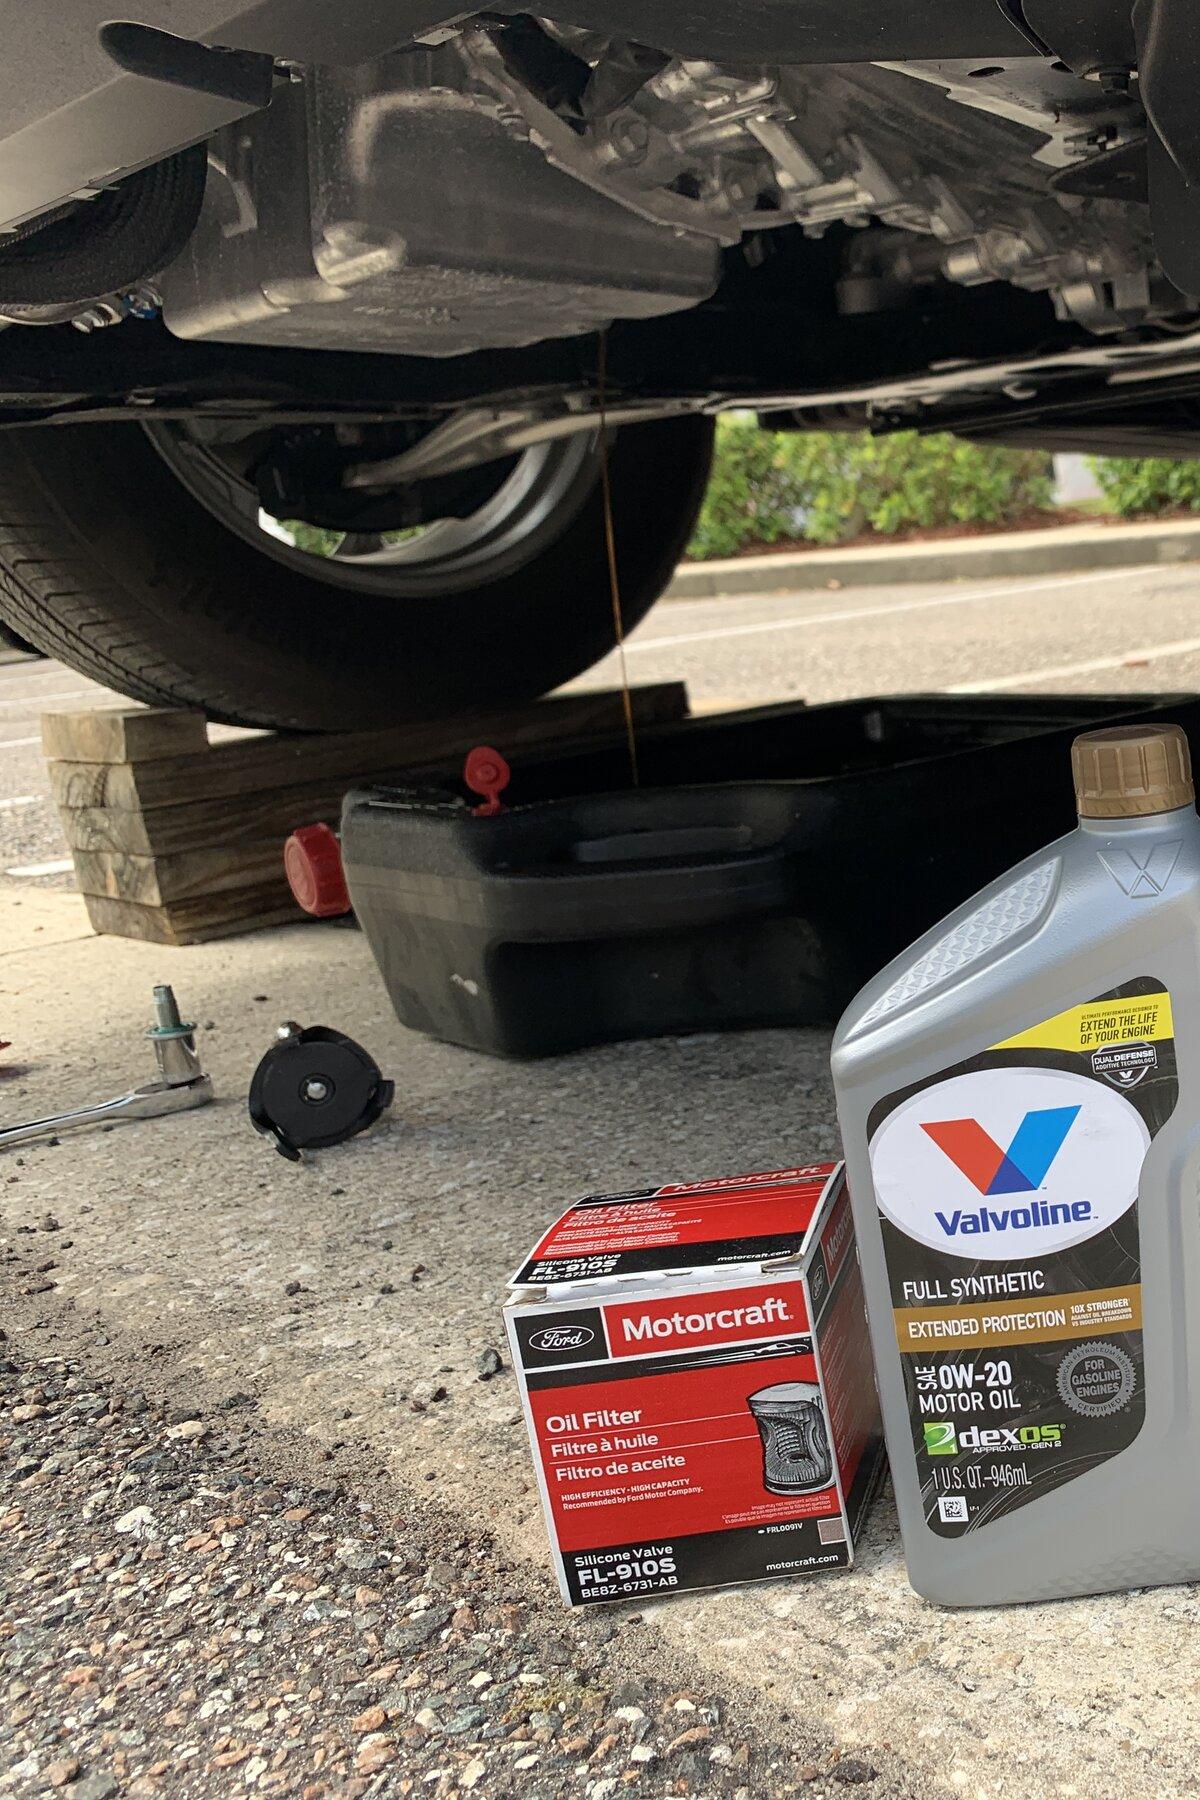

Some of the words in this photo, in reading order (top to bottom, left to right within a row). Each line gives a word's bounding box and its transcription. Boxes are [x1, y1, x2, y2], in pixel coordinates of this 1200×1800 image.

[1081, 1018, 1116, 1032] EXTEND
[1119, 1015, 1135, 1026] THE
[1138, 1012, 1157, 1024] LIFE
[1081, 1034, 1092, 1044] OF
[1095, 1030, 1119, 1042] YOUR
[1122, 1024, 1155, 1038] ENGINE
[1096, 1062, 1119, 1070] ADDITIVE
[1121, 1057, 1154, 1066] TECHNOLOGY
[674, 1166, 821, 1192] Motorcraft
[575, 1207, 604, 1215] Oil
[607, 1202, 657, 1212] Filter
[935, 1200, 1090, 1236] Valvoline
[537, 1258, 585, 1266] Silicone
[718, 1249, 791, 1262] motorcraft.com
[532, 1259, 617, 1275] FL-910S
[903, 1280, 947, 1300] FULL
[950, 1270, 1045, 1298] SYNTHETIC
[1071, 1305, 1085, 1313] 10X
[622, 1298, 789, 1342] Motorcraft
[908, 1318, 979, 1339] EXTENDED
[982, 1310, 1066, 1333] PROTECTION
[939, 1361, 1012, 1389] 0W-20
[1085, 1359, 1105, 1371] FOR
[915, 1366, 937, 1390] SAE
[1072, 1370, 1121, 1385] GASOLINE
[1077, 1382, 1119, 1397] ENGINES
[919, 1391, 984, 1413] MOTOR
[990, 1389, 1021, 1409] OIL
[1078, 1398, 1121, 1411] CERTIFIED
[546, 1413, 579, 1433] Oil
[584, 1408, 642, 1429] Filter
[551, 1440, 597, 1457] Filtre
[602, 1438, 613, 1451] à
[615, 1434, 658, 1449] huile
[959, 1424, 1061, 1447] dexos
[556, 1464, 602, 1482] Filtro
[606, 1461, 632, 1476] de
[635, 1454, 686, 1472] aceite
[932, 1468, 938, 1489] 1
[943, 1466, 965, 1489] U.S.
[563, 1496, 616, 1510] Recommended
[627, 1494, 644, 1502] Ford
[668, 1486, 703, 1496] Company.
[582, 1487, 626, 1498] EFFICIENCY
[652, 1479, 689, 1489] CAPACITY
[767, 1523, 802, 1534] FRL0091V
[575, 1552, 631, 1567] Silicone
[634, 1546, 673, 1559] Valve
[766, 1555, 838, 1571] motorcraft.com
[578, 1558, 677, 1585] FL-910S
[581, 1576, 678, 1598] BE8Z-6731-AB
